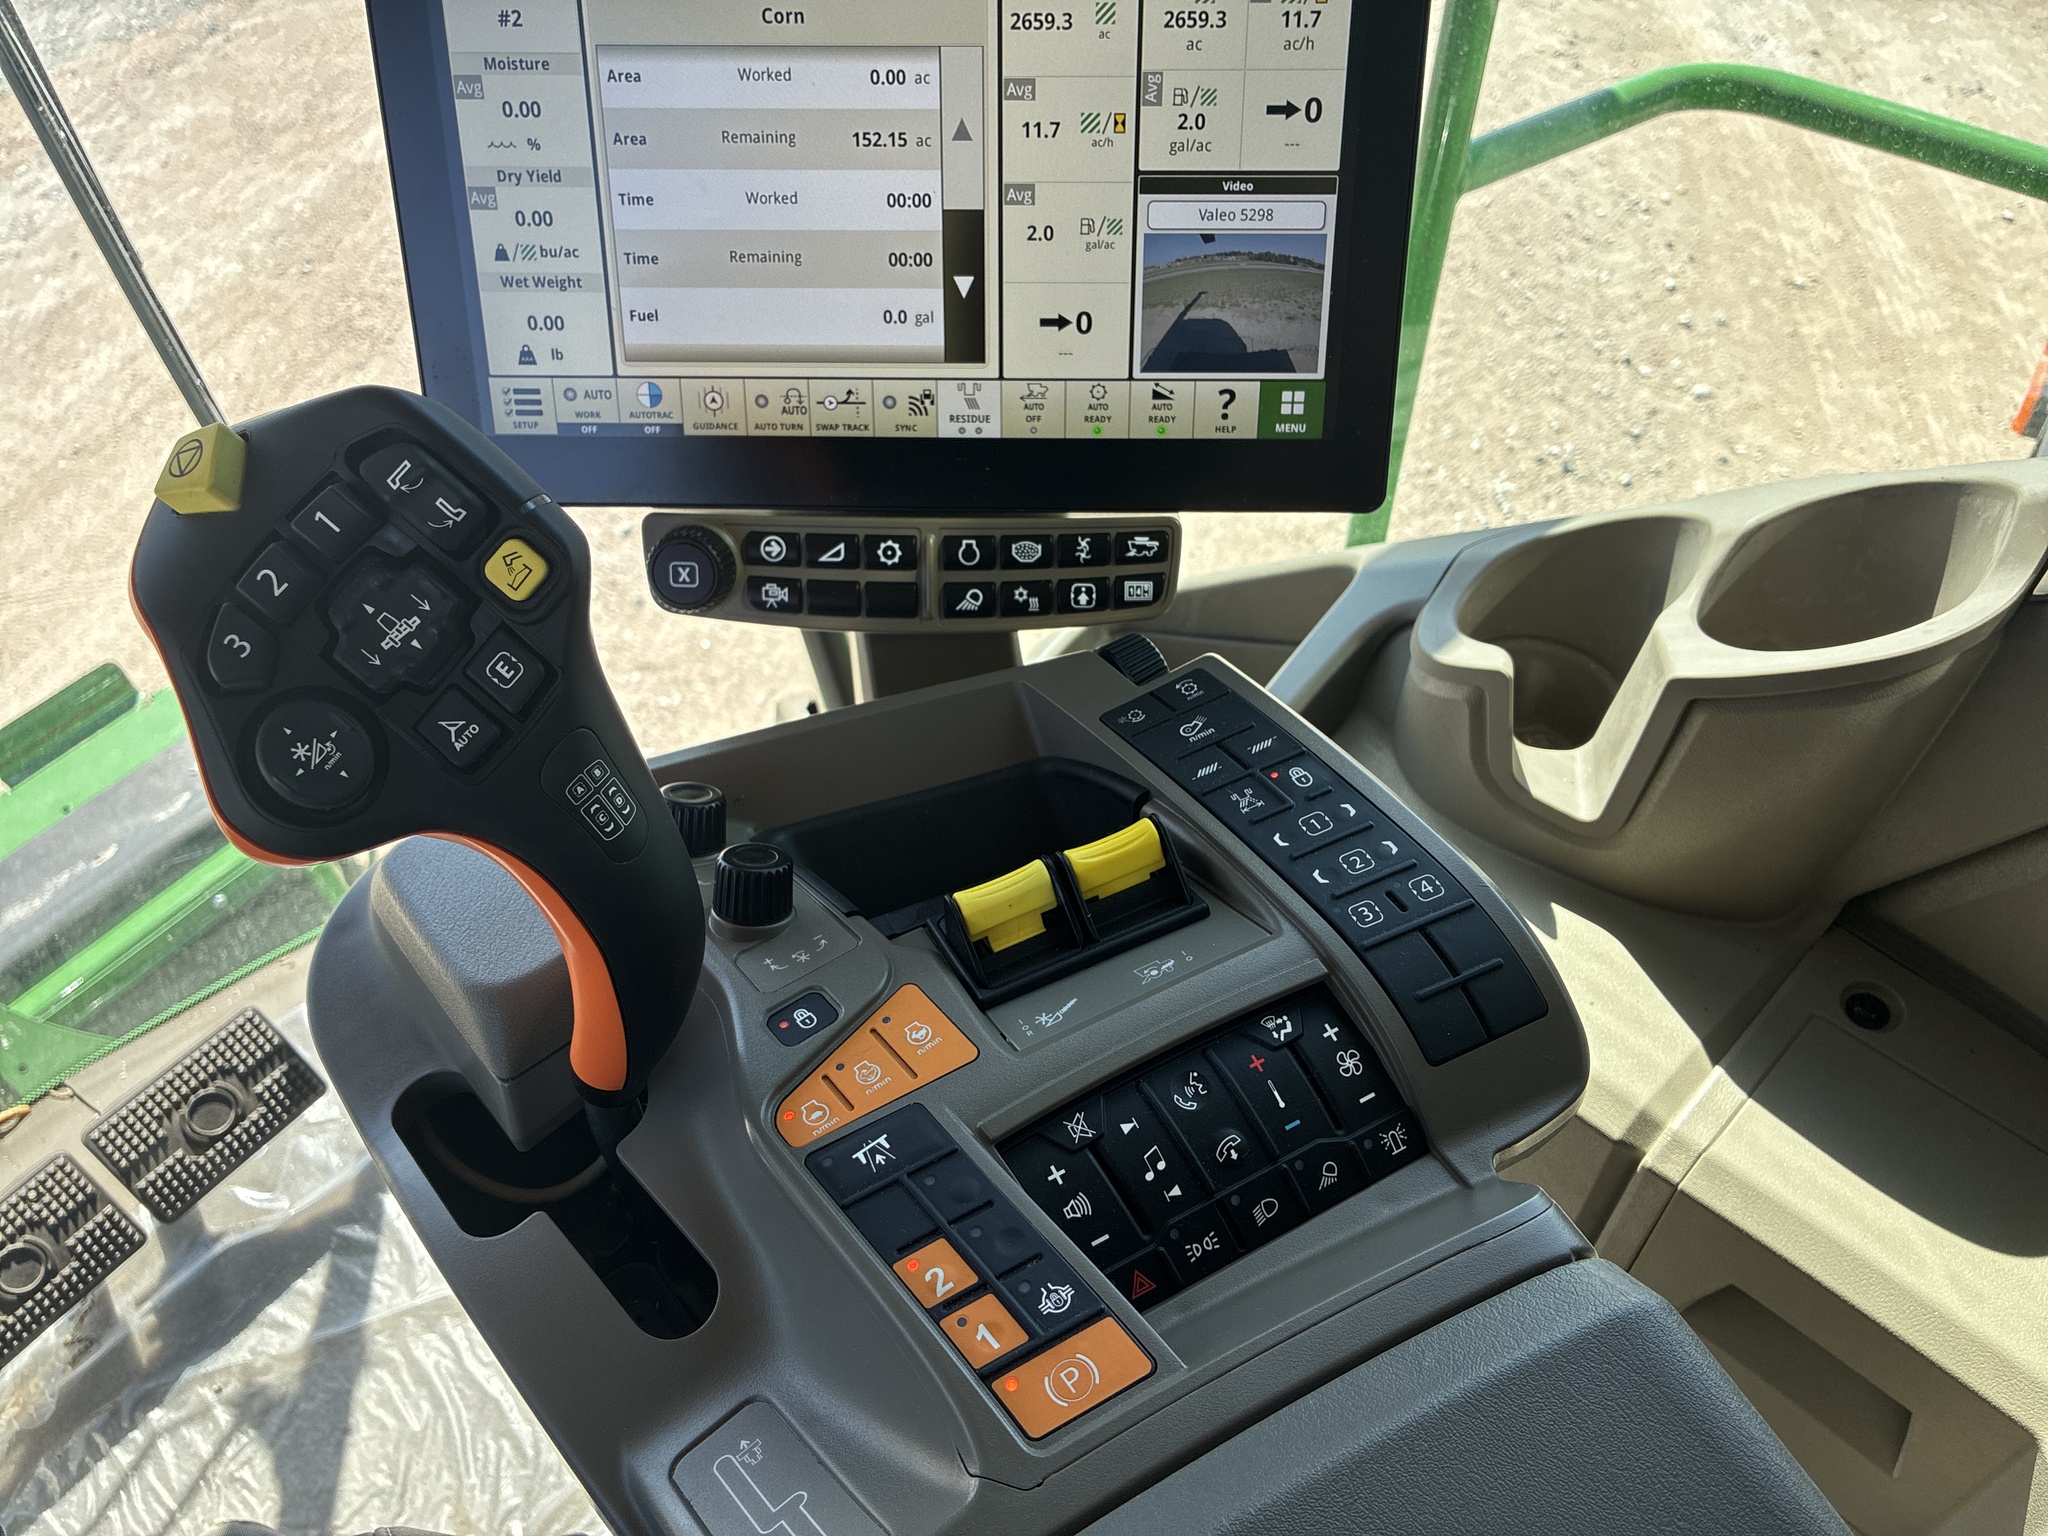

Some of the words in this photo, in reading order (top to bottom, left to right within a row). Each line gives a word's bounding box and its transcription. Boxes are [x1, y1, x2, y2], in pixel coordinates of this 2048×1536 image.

[498, 9, 523, 27] #2
[761, 7, 805, 24] Corn
[1010, 12, 1073, 31] 2659.3
[1163, 10, 1228, 29] 2659.3
[1281, 10, 1322, 28] 11.7
[1098, 29, 1111, 40] ac
[1186, 39, 1203, 51] ac
[1283, 36, 1315, 51] ac/h
[484, 57, 550, 71] Moisture
[607, 69, 641, 83] Area
[737, 67, 792, 82] Worked
[870, 69, 906, 86] 0.00
[915, 73, 931, 85] ac
[457, 80, 482, 98] Avg
[1006, 83, 1033, 100] Avg
[1145, 74, 1162, 103] Avg
[502, 100, 541, 118] 0.00
[1177, 113, 1206, 131] 2.0
[1022, 122, 1061, 139] 11.7
[526, 138, 541, 151] %
[613, 132, 647, 146] Area
[721, 130, 797, 148] Remaining
[852, 132, 908, 148] 152.15
[916, 135, 932, 147] ac
[1091, 137, 1114, 148] ac/h
[1169, 139, 1212, 156] gal/ac
[497, 170, 522, 185] Dry
[526, 170, 562, 183] Yield
[1222, 180, 1254, 192] Video
[471, 192, 497, 208] Avg
[618, 193, 654, 206] Time
[745, 191, 798, 205] Worked
[887, 193, 932, 208] 00:00
[1006, 189, 1033, 205] Avg
[515, 210, 554, 227] 0.00
[1199, 208, 1236, 222] Valeo
[1240, 208, 1275, 222] 5298
[1027, 225, 1054, 242] 2.0
[540, 244, 580, 259] bu/ac
[1085, 239, 1116, 252] gal/ac
[624, 252, 659, 265] Time
[729, 250, 802, 266] Remaining
[888, 252, 933, 267] 00:00
[501, 276, 530, 288] Wet
[532, 276, 583, 291] Weight
[527, 315, 565, 331] 0.00
[629, 309, 659, 322] Fuel
[883, 309, 908, 324] 0.0
[915, 311, 934, 326] gal
[551, 348, 564, 361] lb
[583, 389, 612, 400] AUTO
[781, 405, 808, 416] AUTO
[1023, 403, 1045, 411] AUTO
[1087, 403, 1109, 411] AUTO
[1151, 403, 1173, 411] AUTO
[575, 411, 601, 419] WORK
[629, 411, 674, 419] AUTOTRAC
[949, 414, 991, 424] RESIDUE
[1025, 415, 1042, 423] OFF
[1084, 415, 1112, 424] READY
[1148, 415, 1176, 424] READY
[513, 421, 539, 430] SETUP
[581, 425, 598, 434] OFF
[644, 425, 661, 434] OFF
[693, 421, 738, 431] GUIDANCE
[754, 422, 777, 431] AUTO
[780, 422, 804, 431] TURN
[815, 423, 840, 432] SWAP
[842, 423, 870, 432] TRACK
[894, 423, 918, 432] SYNC
[1214, 425, 1237, 434] HELP
[1275, 423, 1306, 434] MENU
[315, 511, 341, 533] 1
[256, 569, 289, 597] 2
[223, 634, 251, 658] 3
[495, 660, 516, 680] E
[453, 723, 479, 752] AUTO
[1189, 727, 1216, 743] n/min
[324, 751, 343, 771] n/min
[1309, 817, 1322, 830] 1
[1349, 855, 1365, 870] 2
[1420, 880, 1433, 894] 4
[1358, 906, 1373, 922] 3
[917, 1036, 942, 1056] n/min
[865, 1076, 892, 1096] n/min
[812, 1116, 840, 1136] n/min
[924, 1267, 955, 1298] 2
[975, 1323, 1001, 1350] 1
[1059, 1367, 1081, 1394] P
